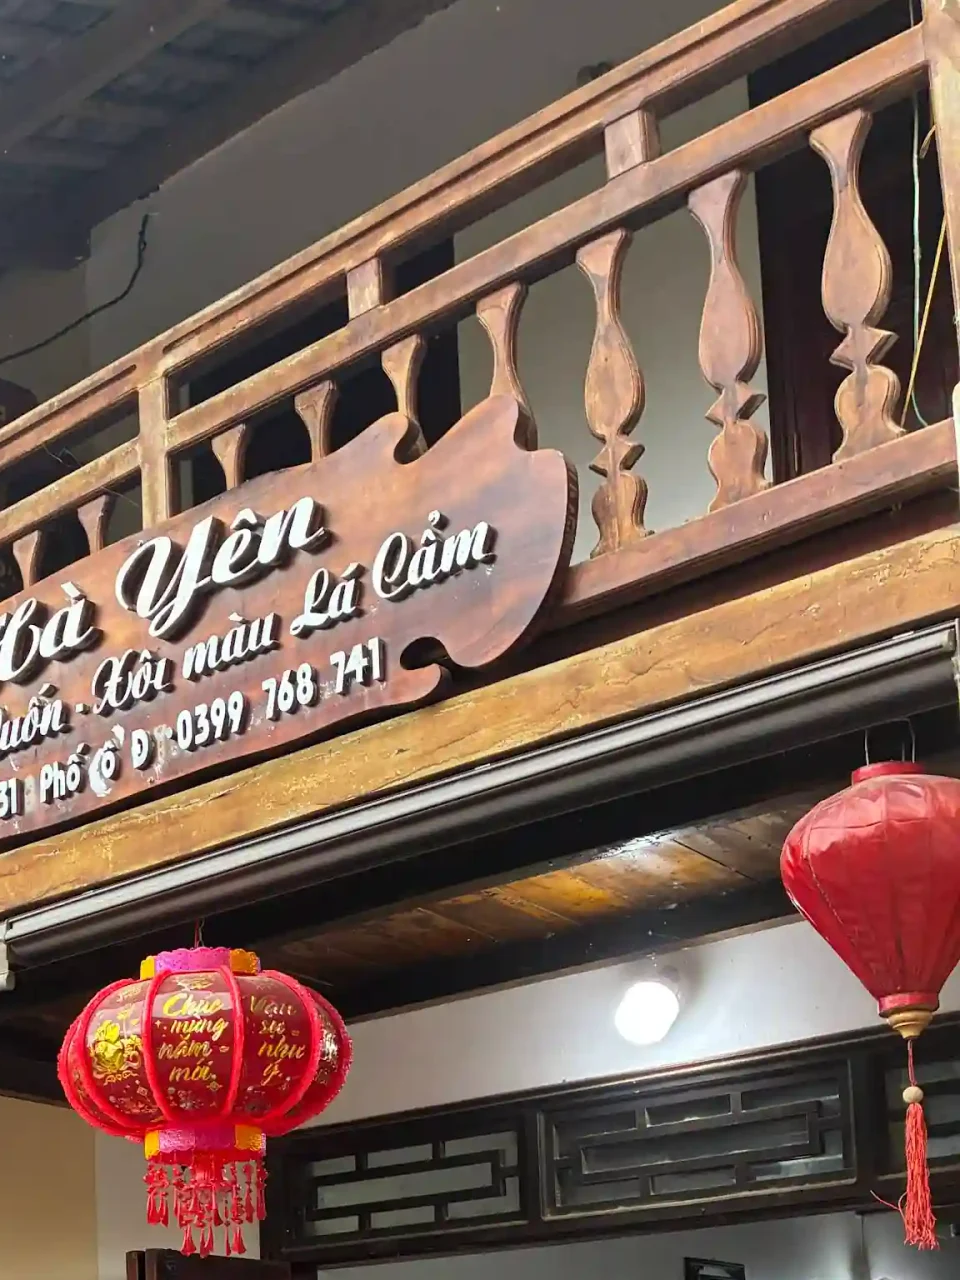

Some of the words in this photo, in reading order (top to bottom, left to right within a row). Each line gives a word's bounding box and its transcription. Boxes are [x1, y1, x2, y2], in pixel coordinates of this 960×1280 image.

[115, 496, 326, 637] Yên
[182, 613, 280, 680] màu
[289, 562, 364, 636] Lá
[372, 509, 496, 599] Cẩm
[40, 743, 88, 804] Phố
[262, 663, 315, 721] 768
[330, 637, 385, 695] 741
